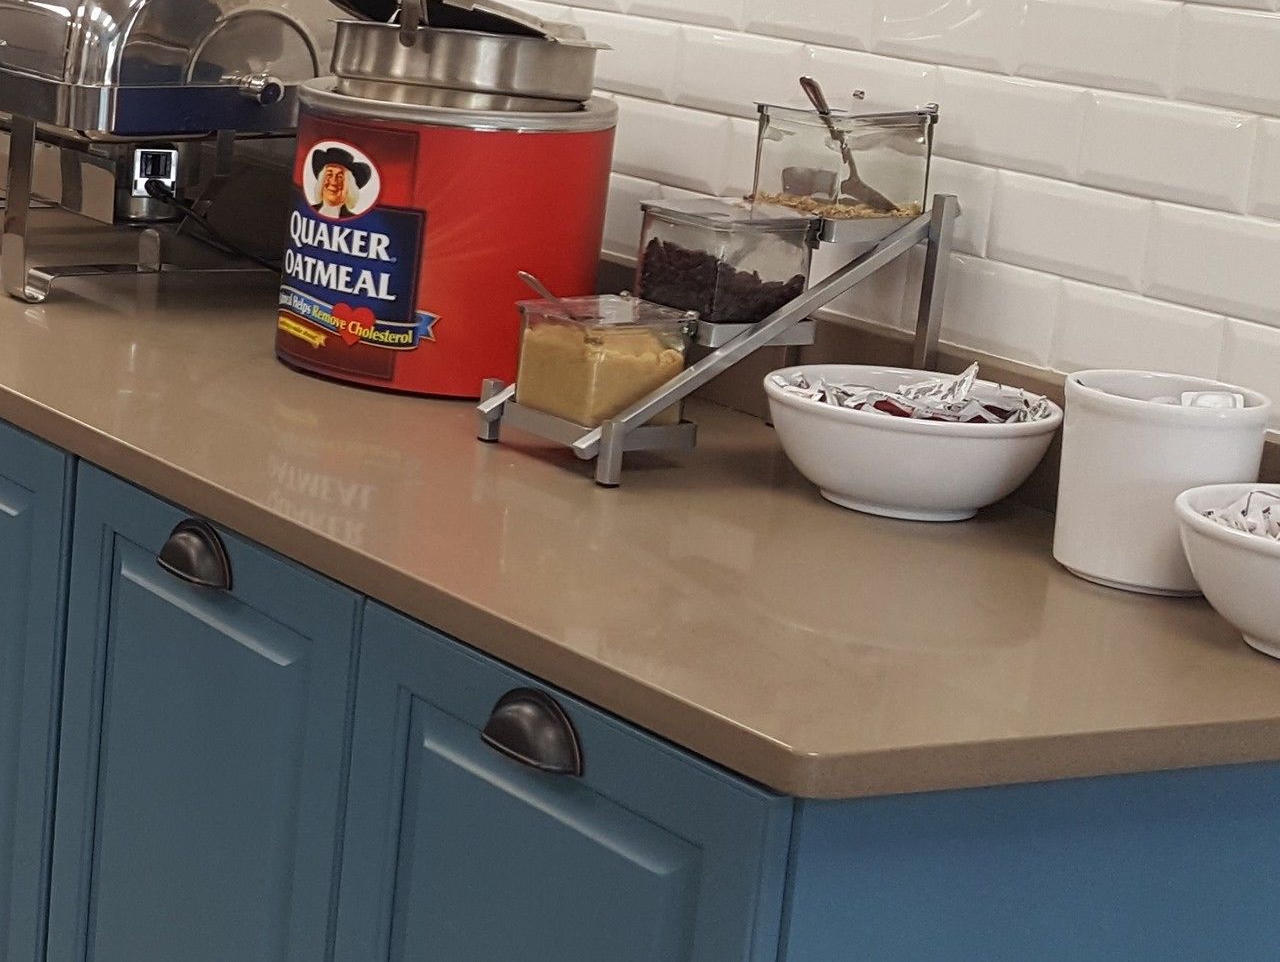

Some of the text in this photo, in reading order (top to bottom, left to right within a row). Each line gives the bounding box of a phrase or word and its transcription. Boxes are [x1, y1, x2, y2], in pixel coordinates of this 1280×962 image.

[290, 210, 393, 263] QUAKER
[284, 248, 397, 301] OATMEAL
[292, 293, 312, 315] Helps
[311, 306, 348, 330] Remove
[347, 320, 413, 344] Cholesterol
